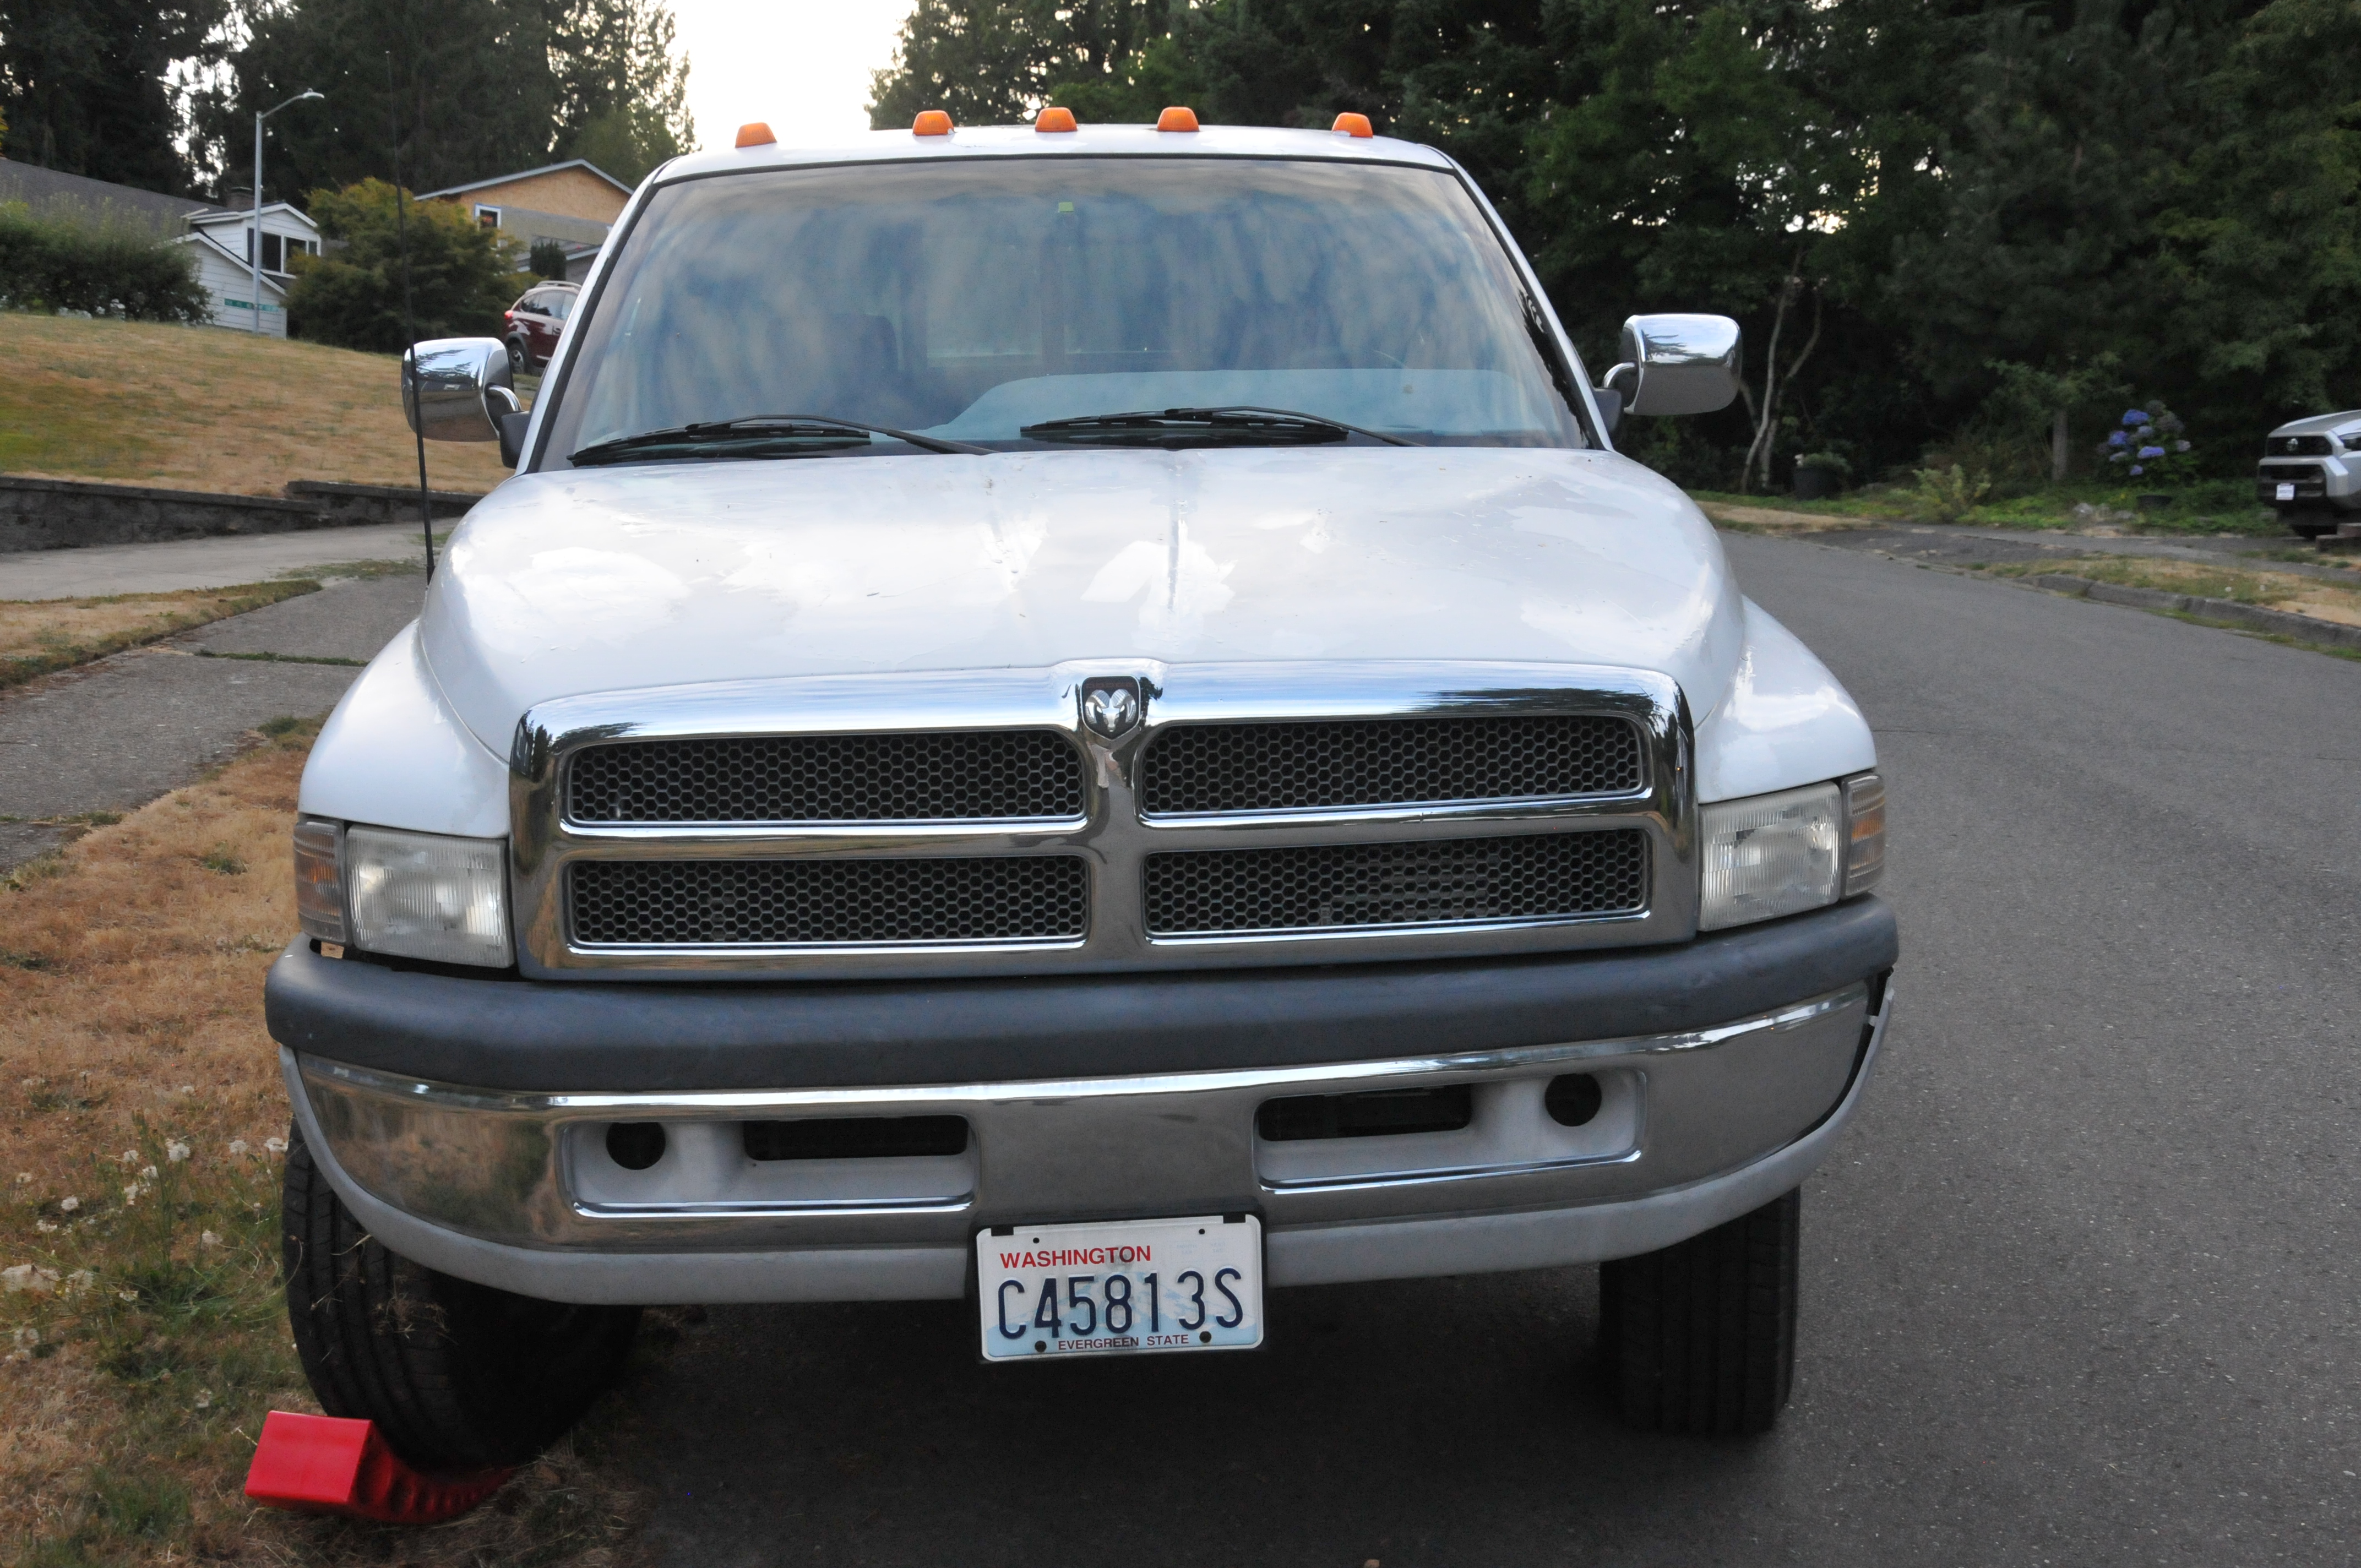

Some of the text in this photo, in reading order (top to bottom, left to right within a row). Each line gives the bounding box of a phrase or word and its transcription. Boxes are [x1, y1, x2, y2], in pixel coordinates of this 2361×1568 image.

[1000, 1245, 1151, 1268] WASHINGTON
[998, 1267, 1243, 1340] C45813S
[1058, 1334, 1189, 1351] EVERGREEN STATE
